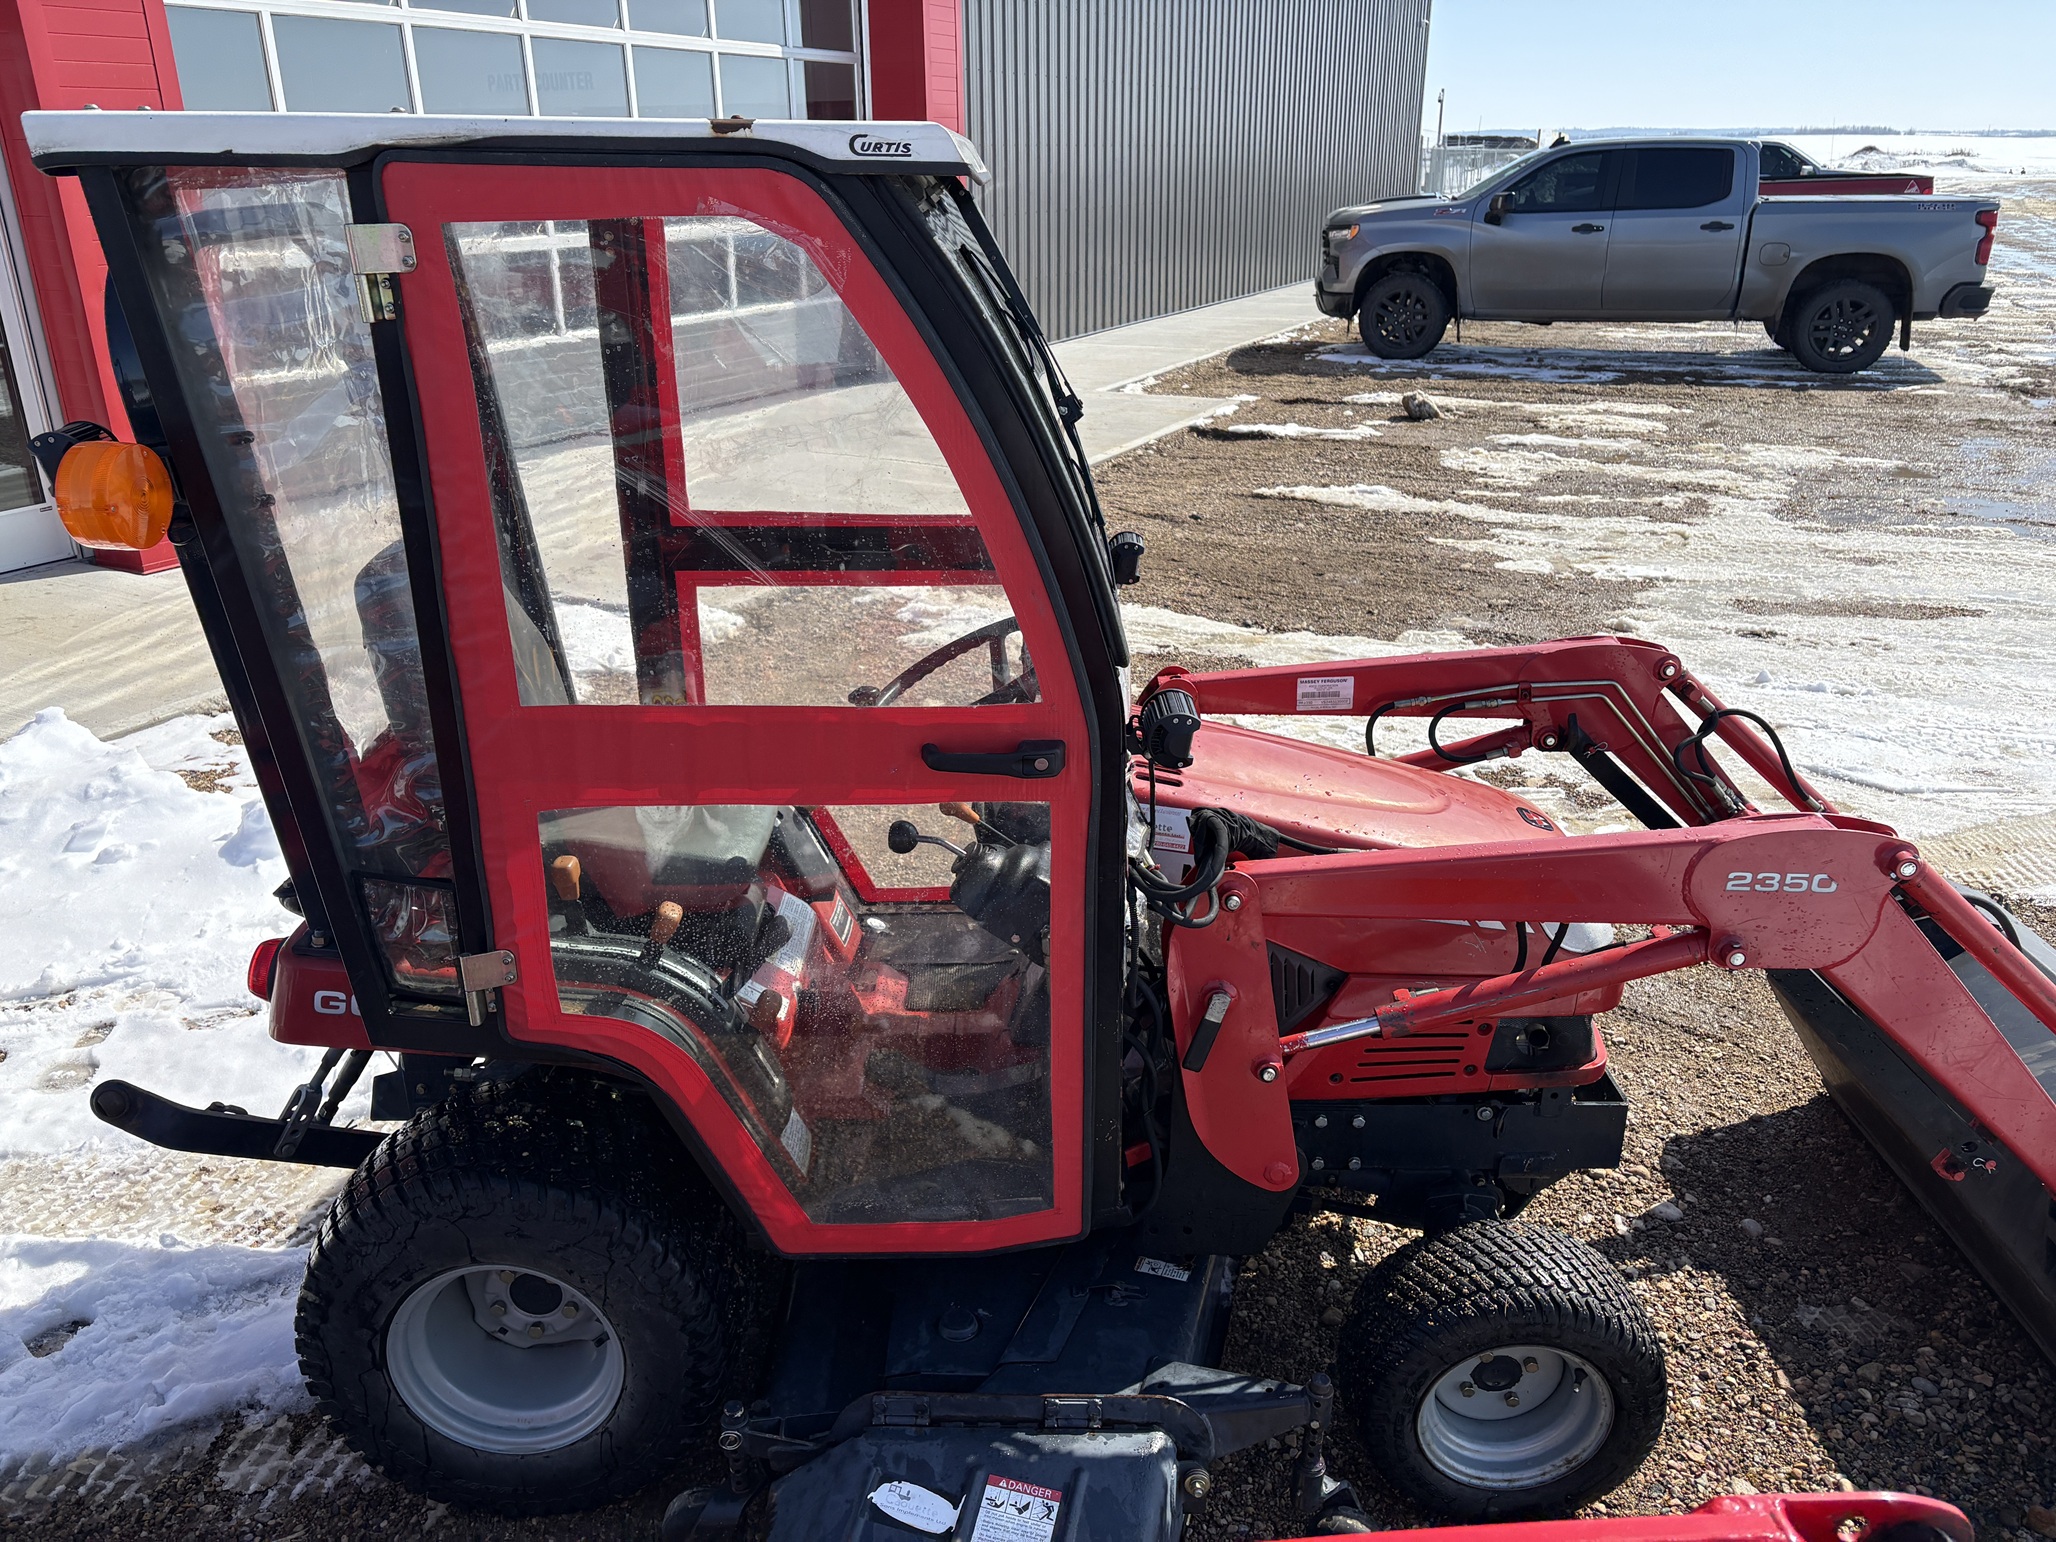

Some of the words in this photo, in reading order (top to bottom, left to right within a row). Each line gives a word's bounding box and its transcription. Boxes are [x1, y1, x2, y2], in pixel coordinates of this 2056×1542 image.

[849, 134, 912, 157] CURTIS
[1726, 871, 1838, 893] 2350
[1008, 1480, 1052, 1499] DANGER
